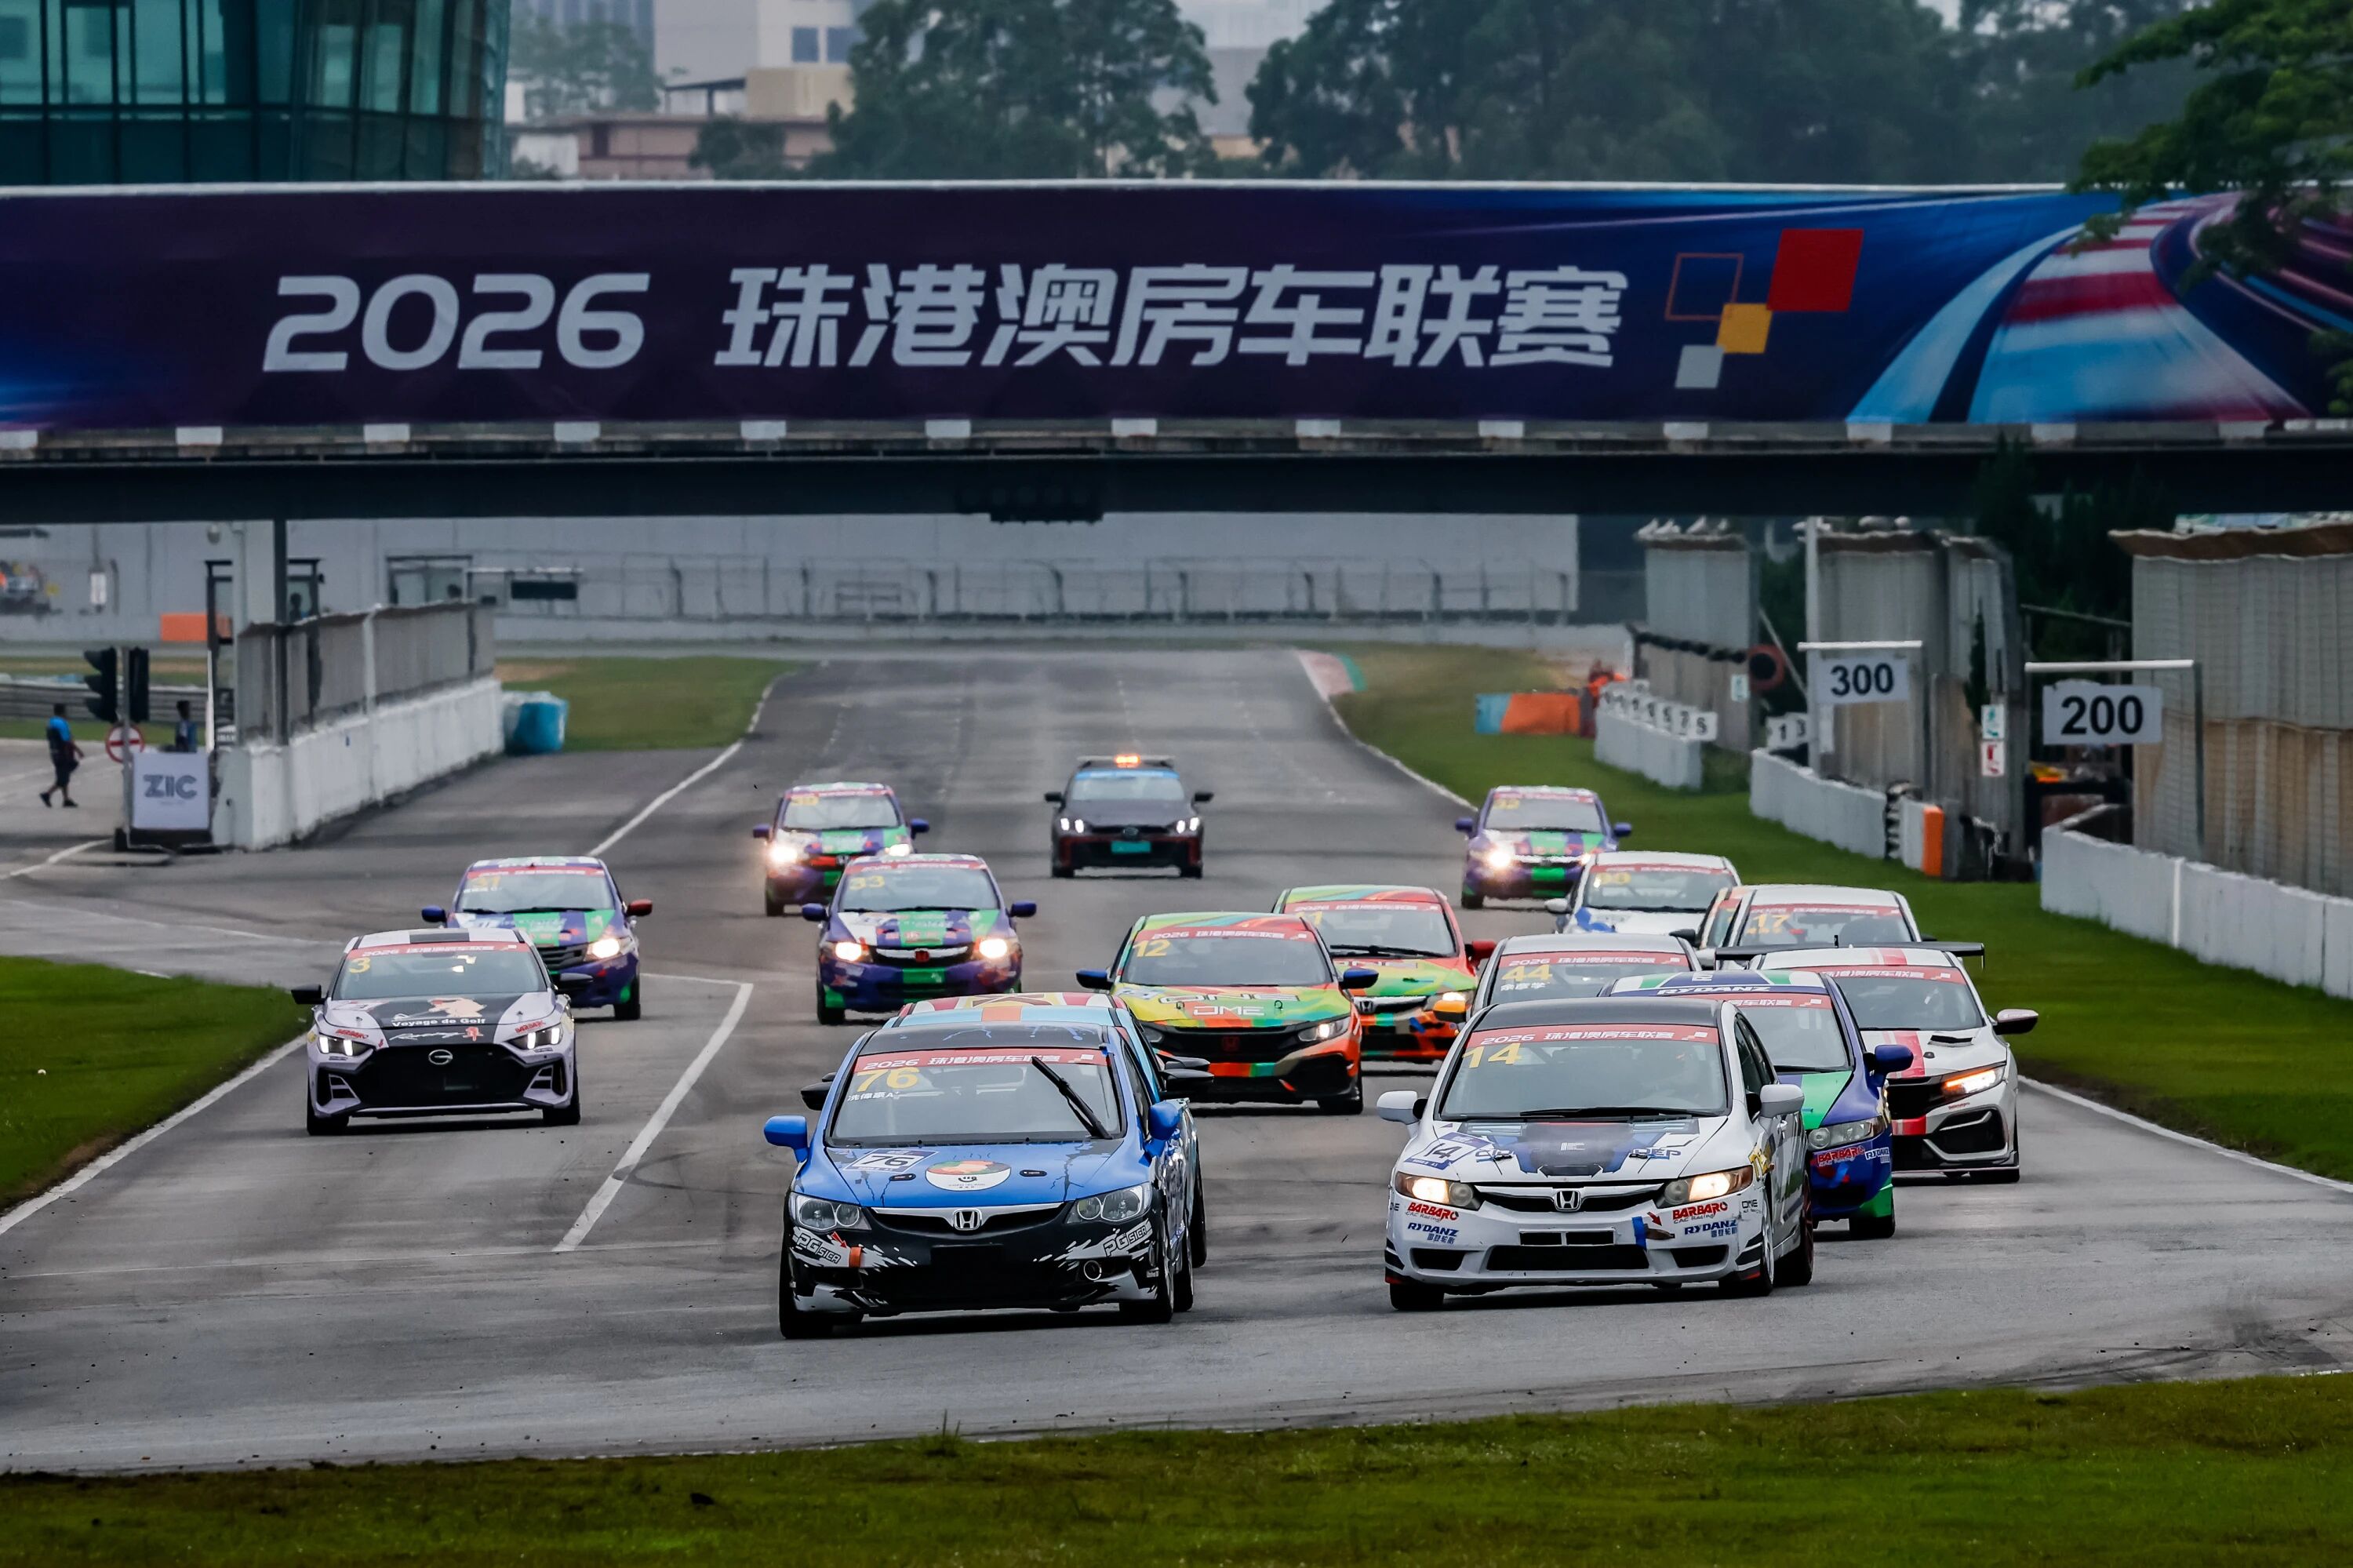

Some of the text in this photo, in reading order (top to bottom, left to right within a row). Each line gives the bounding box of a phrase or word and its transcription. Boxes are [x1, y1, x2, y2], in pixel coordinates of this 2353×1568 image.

[263, 263, 1628, 371] 2026 珠港澳房车联赛
[1831, 663, 1894, 696] 300
[2060, 695, 2144, 736] 200
[143, 774, 198, 799] ZIC
[1133, 940, 1172, 957] 12
[349, 958, 371, 973] 3
[1508, 958, 1551, 966] 2026
[1500, 964, 1552, 981] 44
[1657, 986, 1770, 995] RYDANZ
[1481, 1031, 1675, 1045] 2026 珠港澳房车联赛
[864, 1055, 1061, 1070] 2026 珠港澳房车联赛
[1462, 1042, 1524, 1068] 14
[856, 1067, 921, 1093] 76
[1424, 1142, 1463, 1159] 14
[861, 1155, 915, 1166] 76
[1407, 1202, 1459, 1221] BARBARO
[1672, 1201, 1728, 1220] BARBARO
[1407, 1222, 1460, 1237] RYDANZ
[1684, 1219, 1738, 1235] RYDANZ
